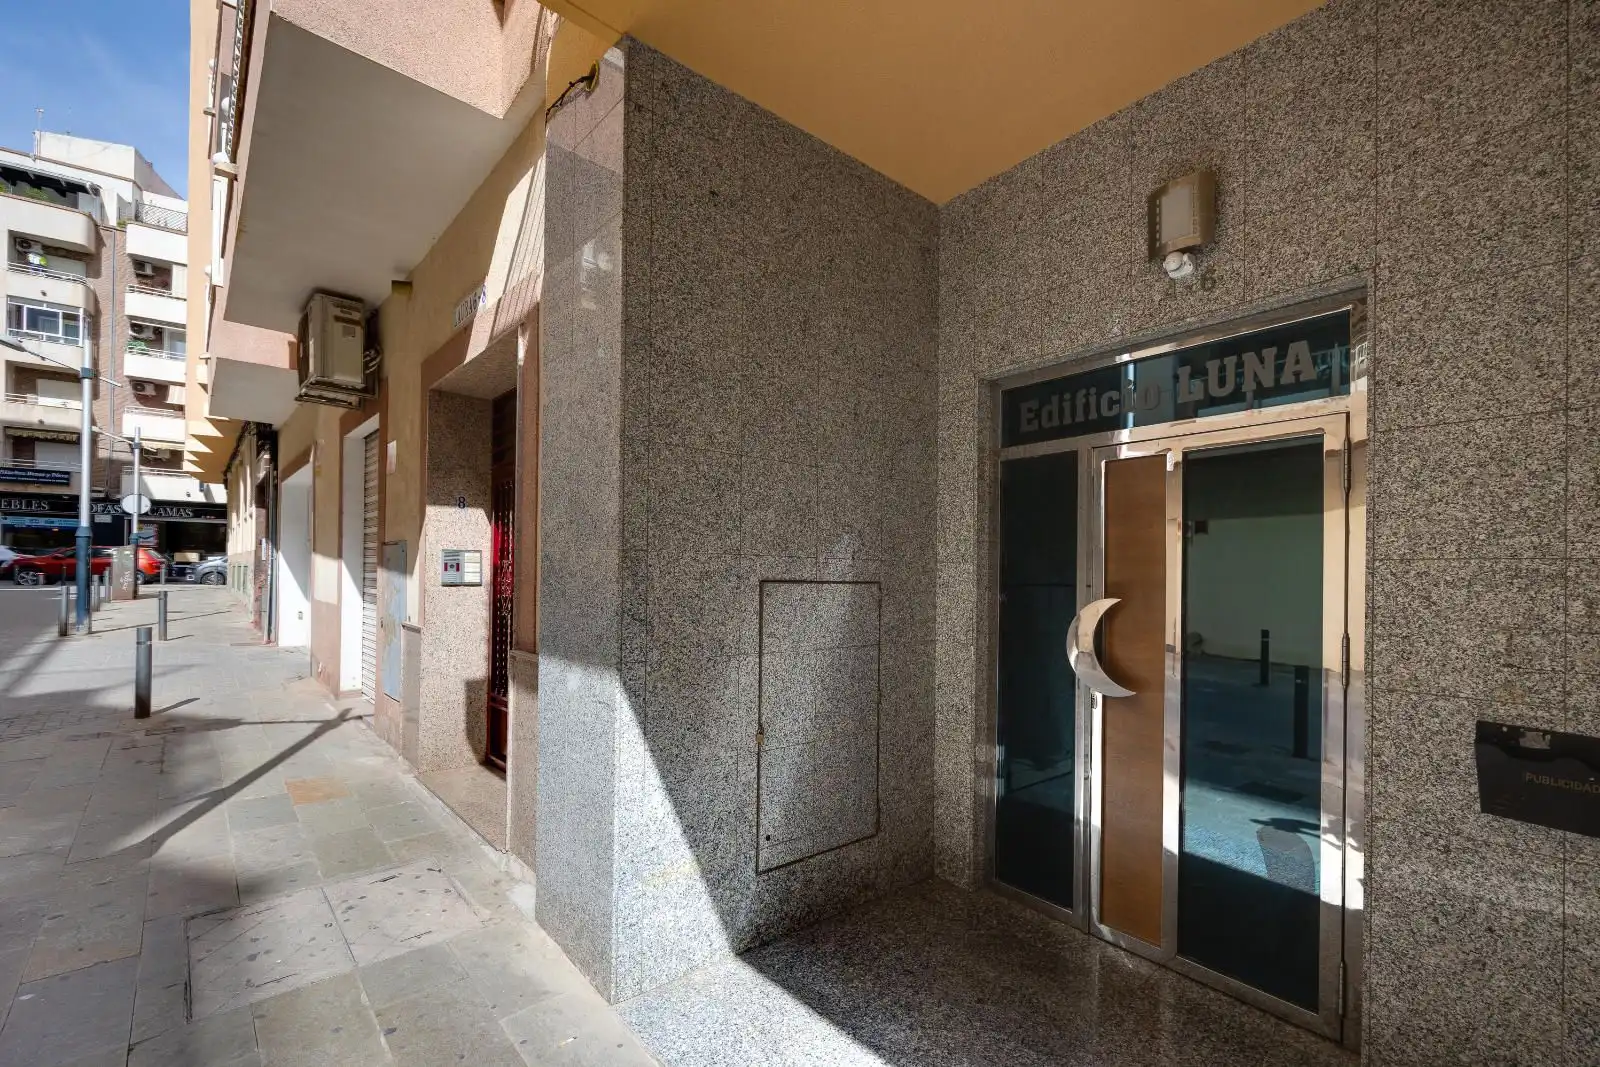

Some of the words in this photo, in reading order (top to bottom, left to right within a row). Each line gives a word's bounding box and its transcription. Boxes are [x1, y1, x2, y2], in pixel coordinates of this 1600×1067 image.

[1019, 380, 1162, 434] Edificio
[1177, 340, 1318, 404] LUNA
[1, 499, 49, 511] EBLES
[458, 496, 466, 509] 8
[147, 506, 193, 518] CAMAS
[1525, 771, 1600, 794] PUBLICIDAD
